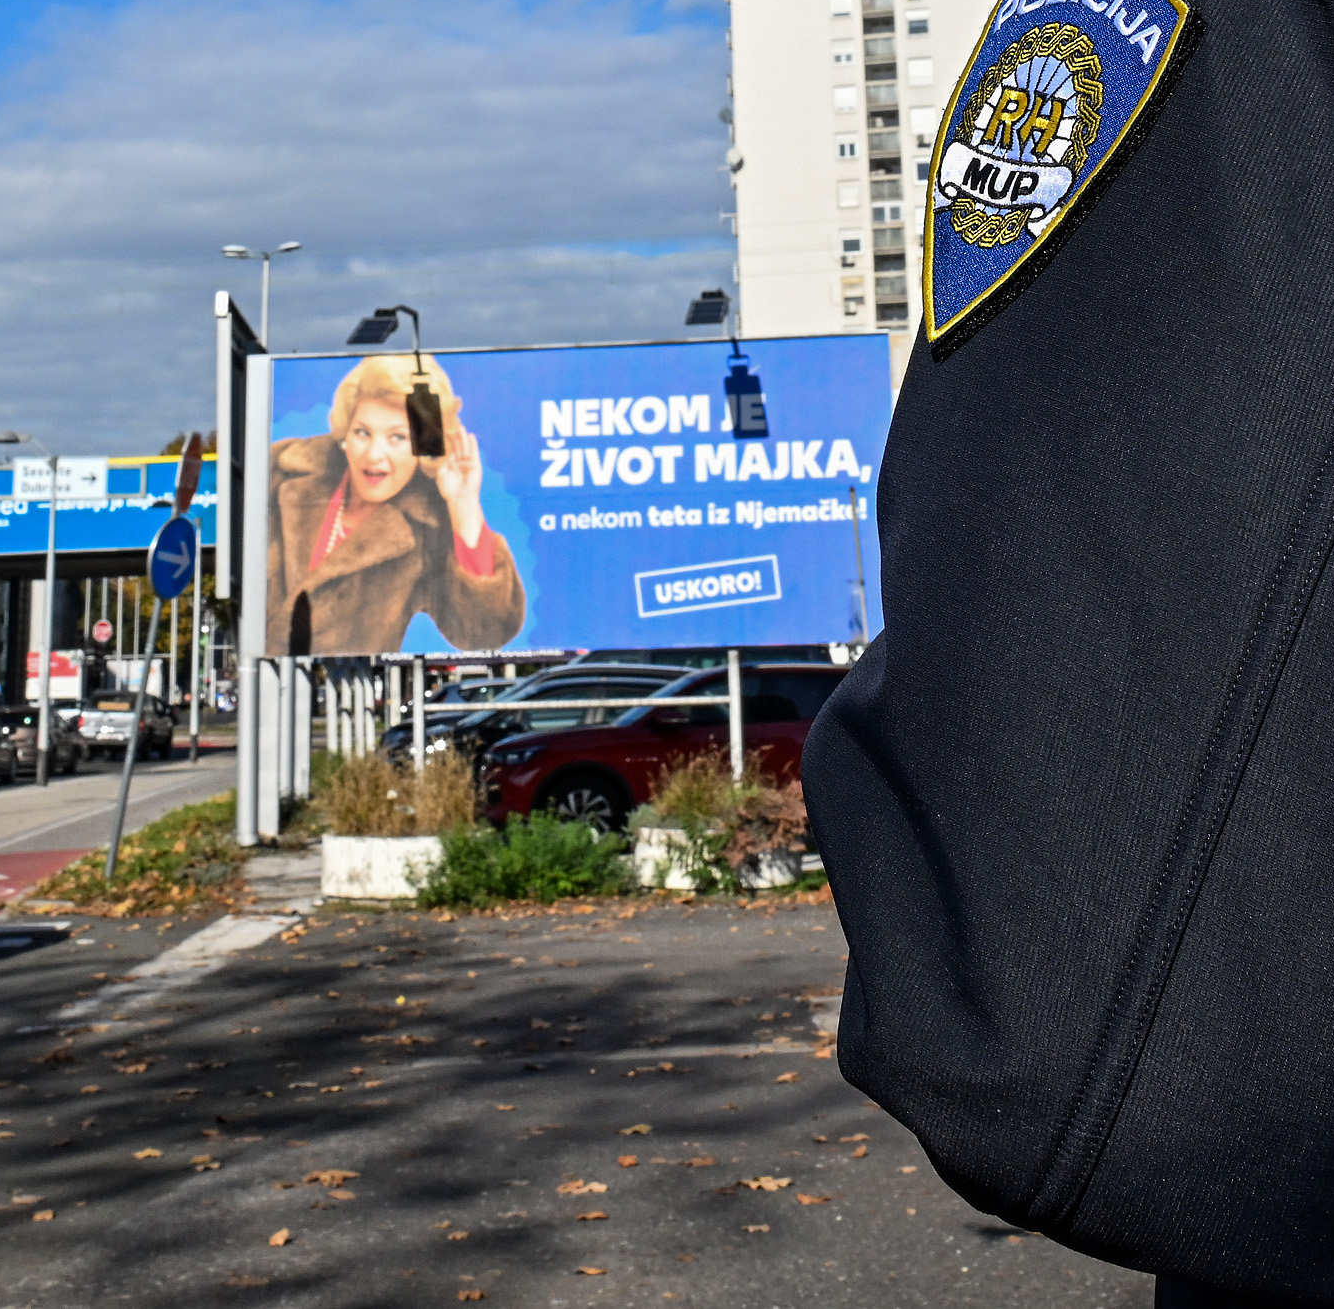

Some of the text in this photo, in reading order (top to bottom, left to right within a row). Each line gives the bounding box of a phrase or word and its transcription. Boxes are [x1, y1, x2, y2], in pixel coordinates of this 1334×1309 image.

[983, 88, 1066, 154] RH
[962, 157, 1039, 202] MUP
[540, 393, 767, 438] NEKOM JE
[22, 465, 72, 477] Sesvte
[540, 438, 873, 487] ŽIVOT MAJKA,
[21, 481, 72, 493] Dubrva
[539, 498, 868, 531] a nekom teta iz Njemačke!
[655, 570, 762, 604] USKORO!
